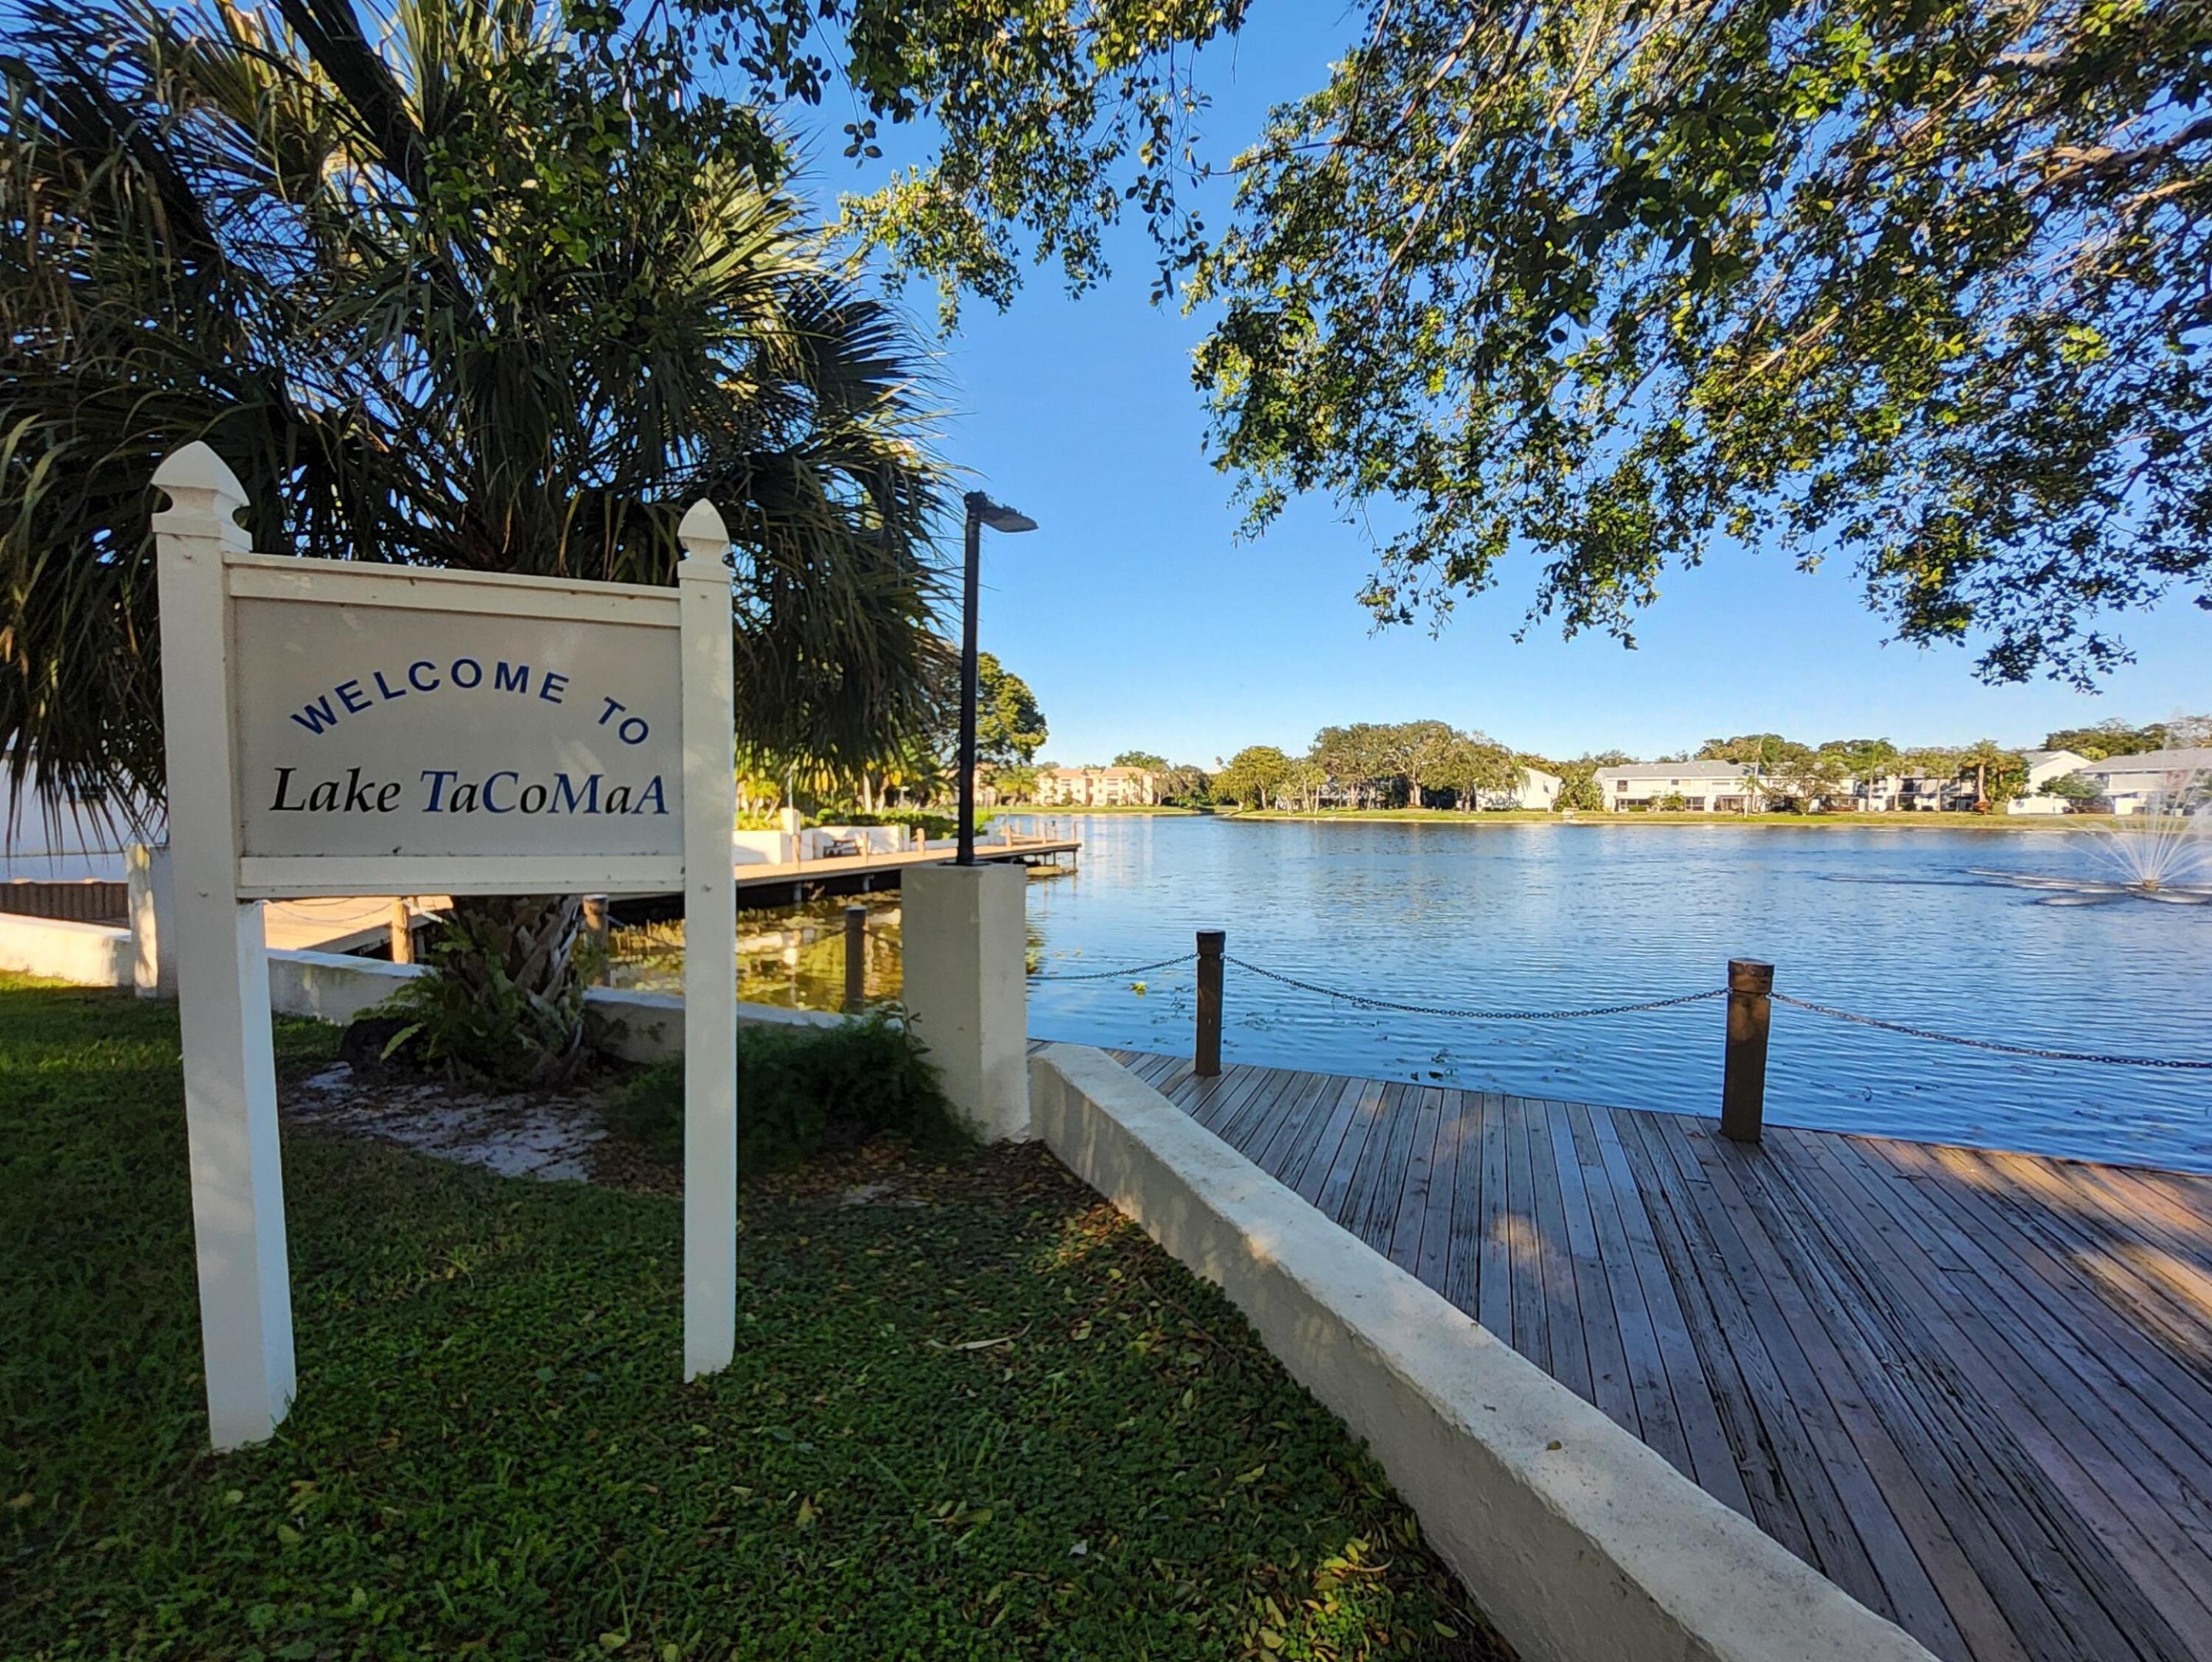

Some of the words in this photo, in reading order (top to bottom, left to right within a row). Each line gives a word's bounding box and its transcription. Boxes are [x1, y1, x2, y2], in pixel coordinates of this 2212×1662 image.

[290, 658, 570, 736] WELCOME
[597, 696, 650, 745] TO
[268, 766, 401, 813] Lake
[419, 770, 670, 815] TaCoMaA
